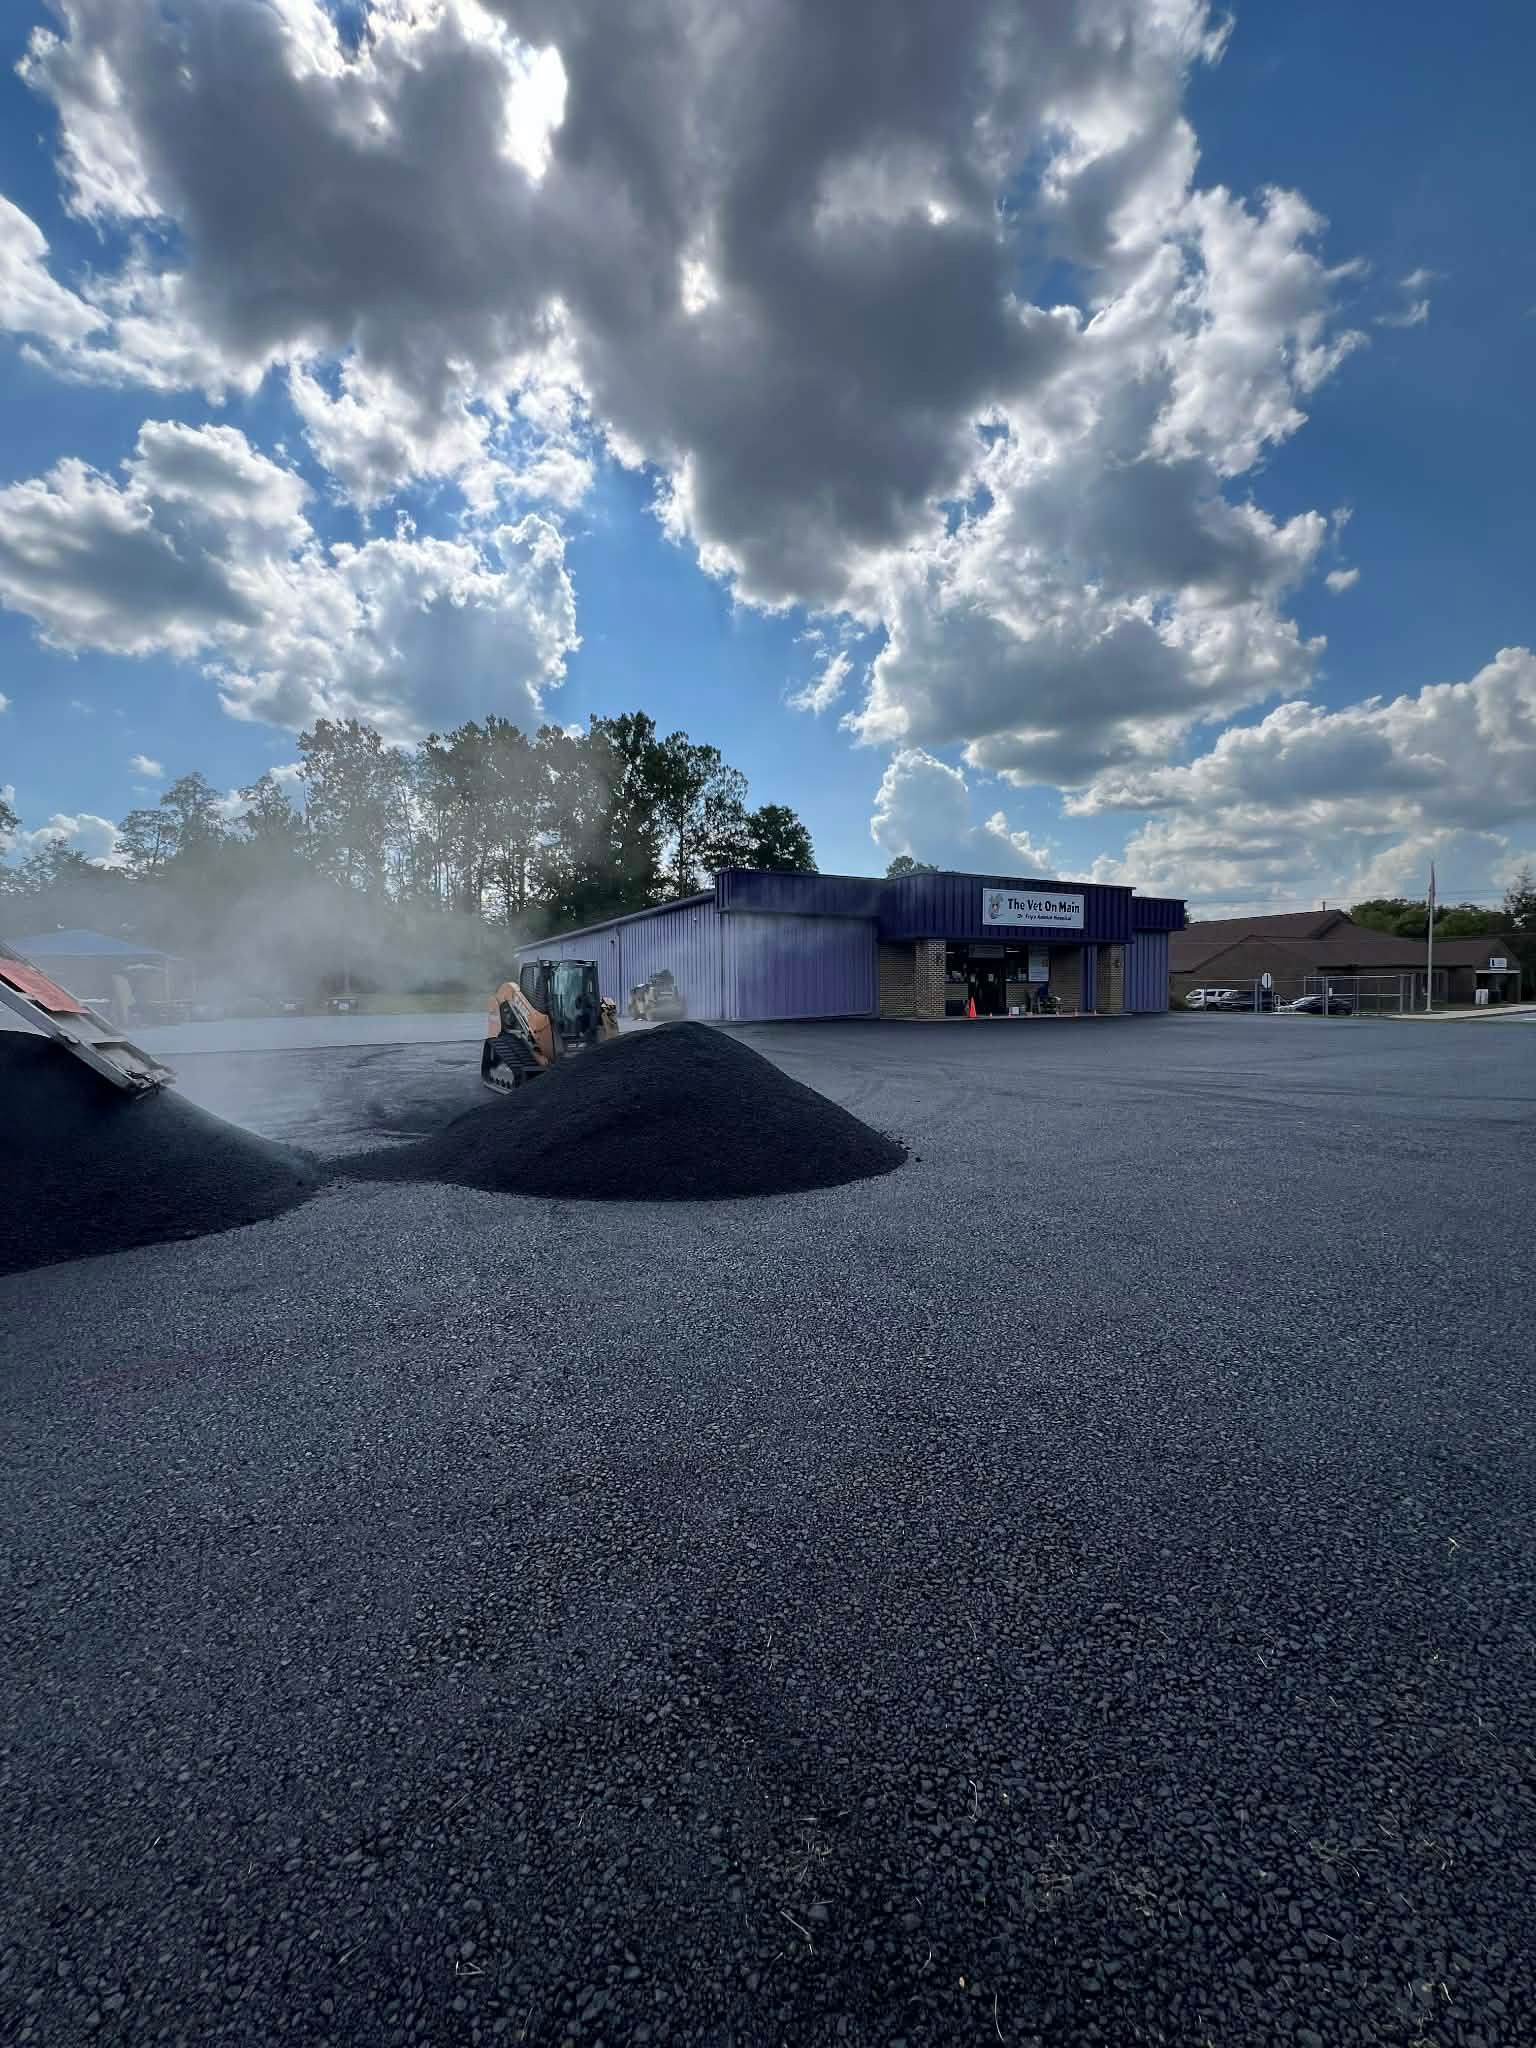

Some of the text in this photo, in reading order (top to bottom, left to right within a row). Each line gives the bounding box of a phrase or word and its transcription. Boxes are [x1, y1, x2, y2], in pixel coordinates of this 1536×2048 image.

[1007, 898, 1080, 914] The Vet On Main
